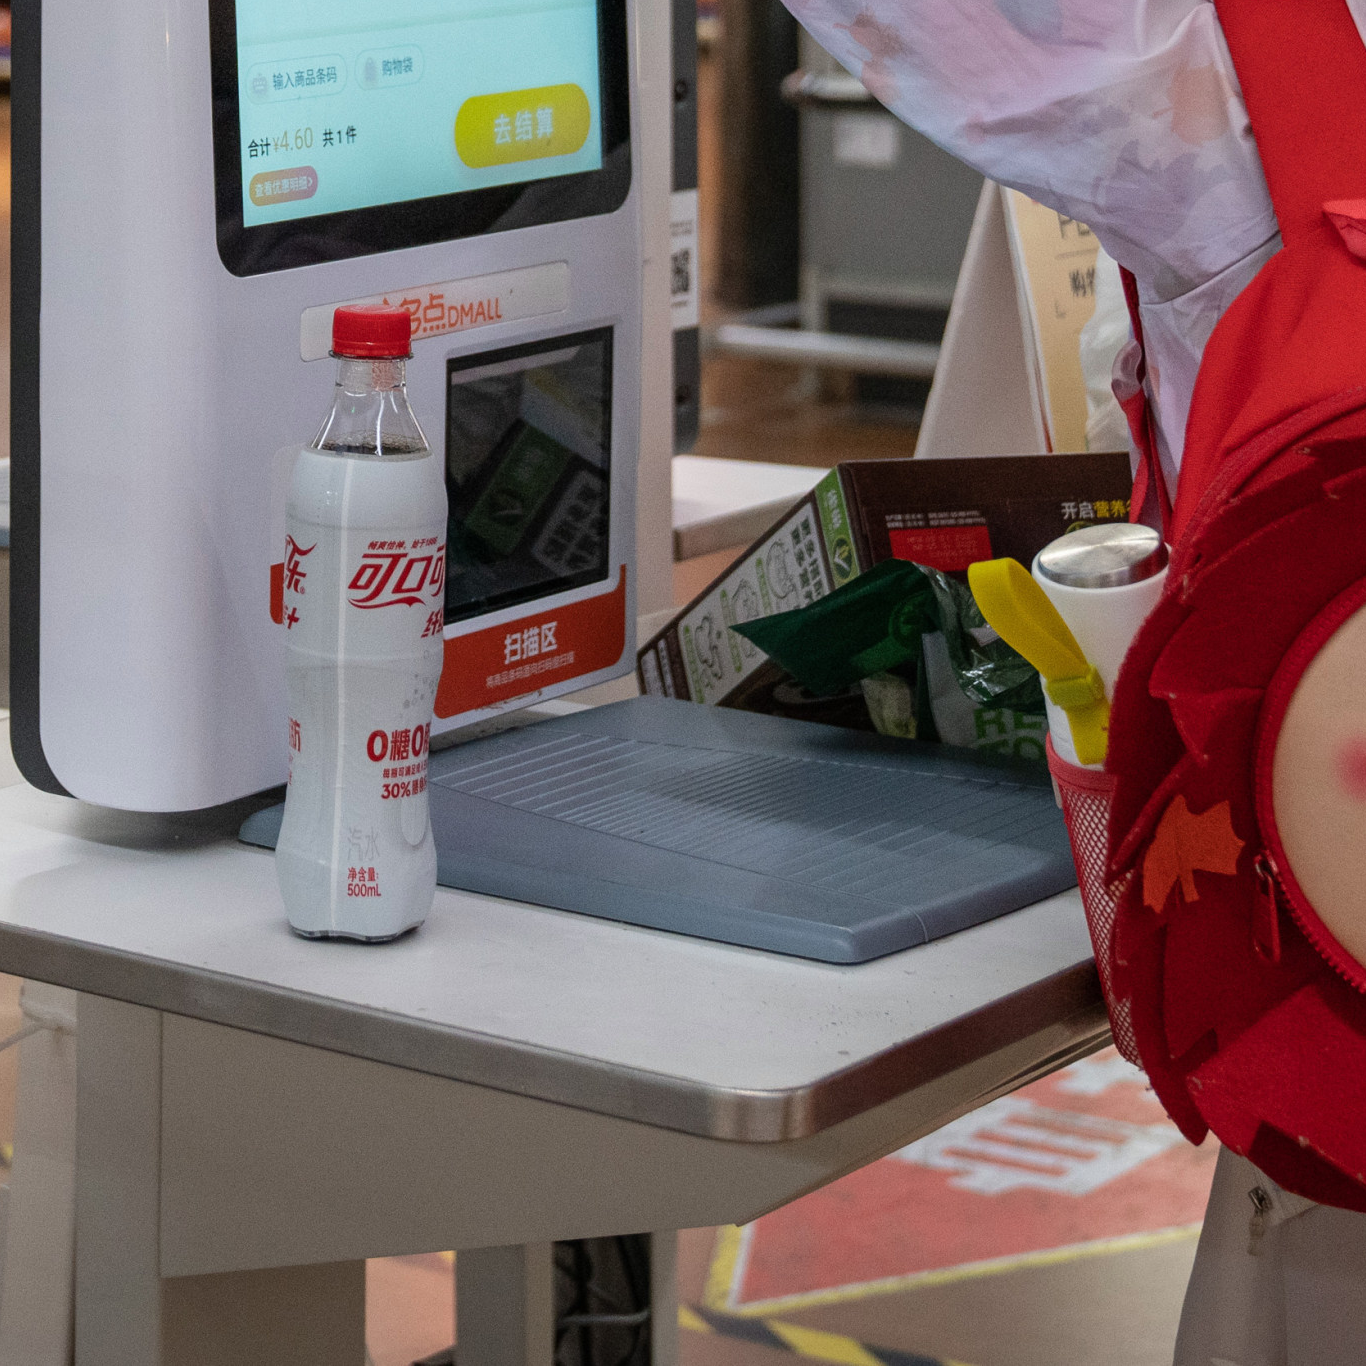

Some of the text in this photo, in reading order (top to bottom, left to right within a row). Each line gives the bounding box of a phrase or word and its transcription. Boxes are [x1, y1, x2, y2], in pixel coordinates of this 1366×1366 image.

[272, 57, 414, 91] 输入商品条码 购物袋
[494, 107, 554, 145] 去结算
[504, 620, 558, 665] 扫描区
[346, 825, 381, 862] 汽水
[347, 882, 382, 898] 500mL
